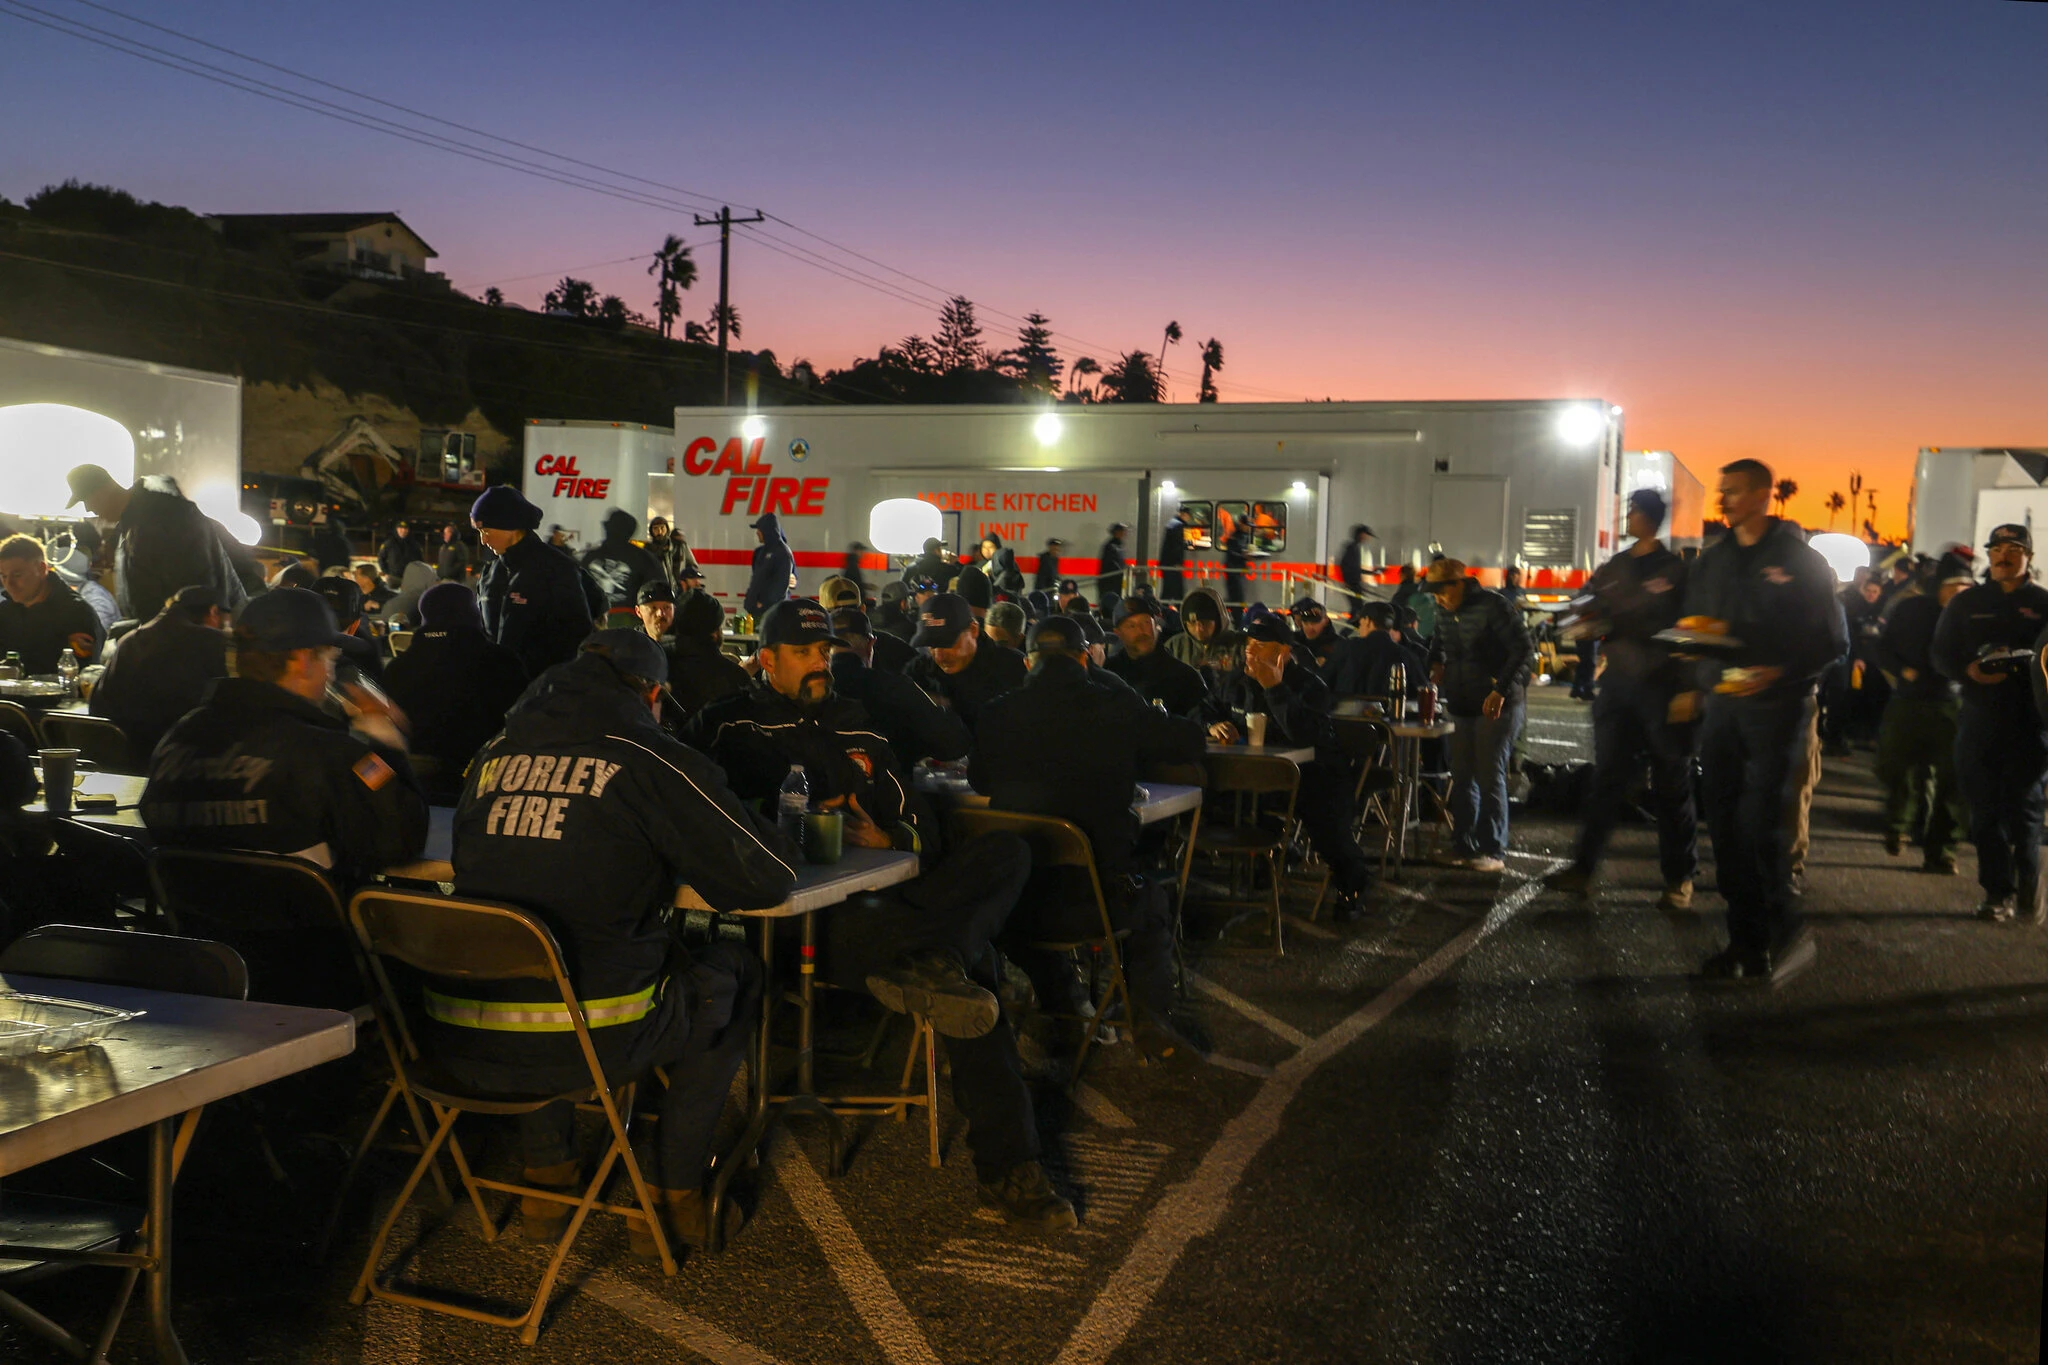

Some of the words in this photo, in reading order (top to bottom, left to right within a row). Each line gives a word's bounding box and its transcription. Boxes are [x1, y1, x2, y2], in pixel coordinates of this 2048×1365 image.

[535, 454, 581, 476] CAL
[683, 436, 772, 477] CAL
[553, 478, 611, 499] FIRE
[720, 477, 830, 516] FIRE
[1003, 493, 1097, 512] KITCHEN
[979, 522, 1029, 541] UNIT
[476, 754, 623, 799] WORLEY
[486, 794, 570, 840] FIRE
